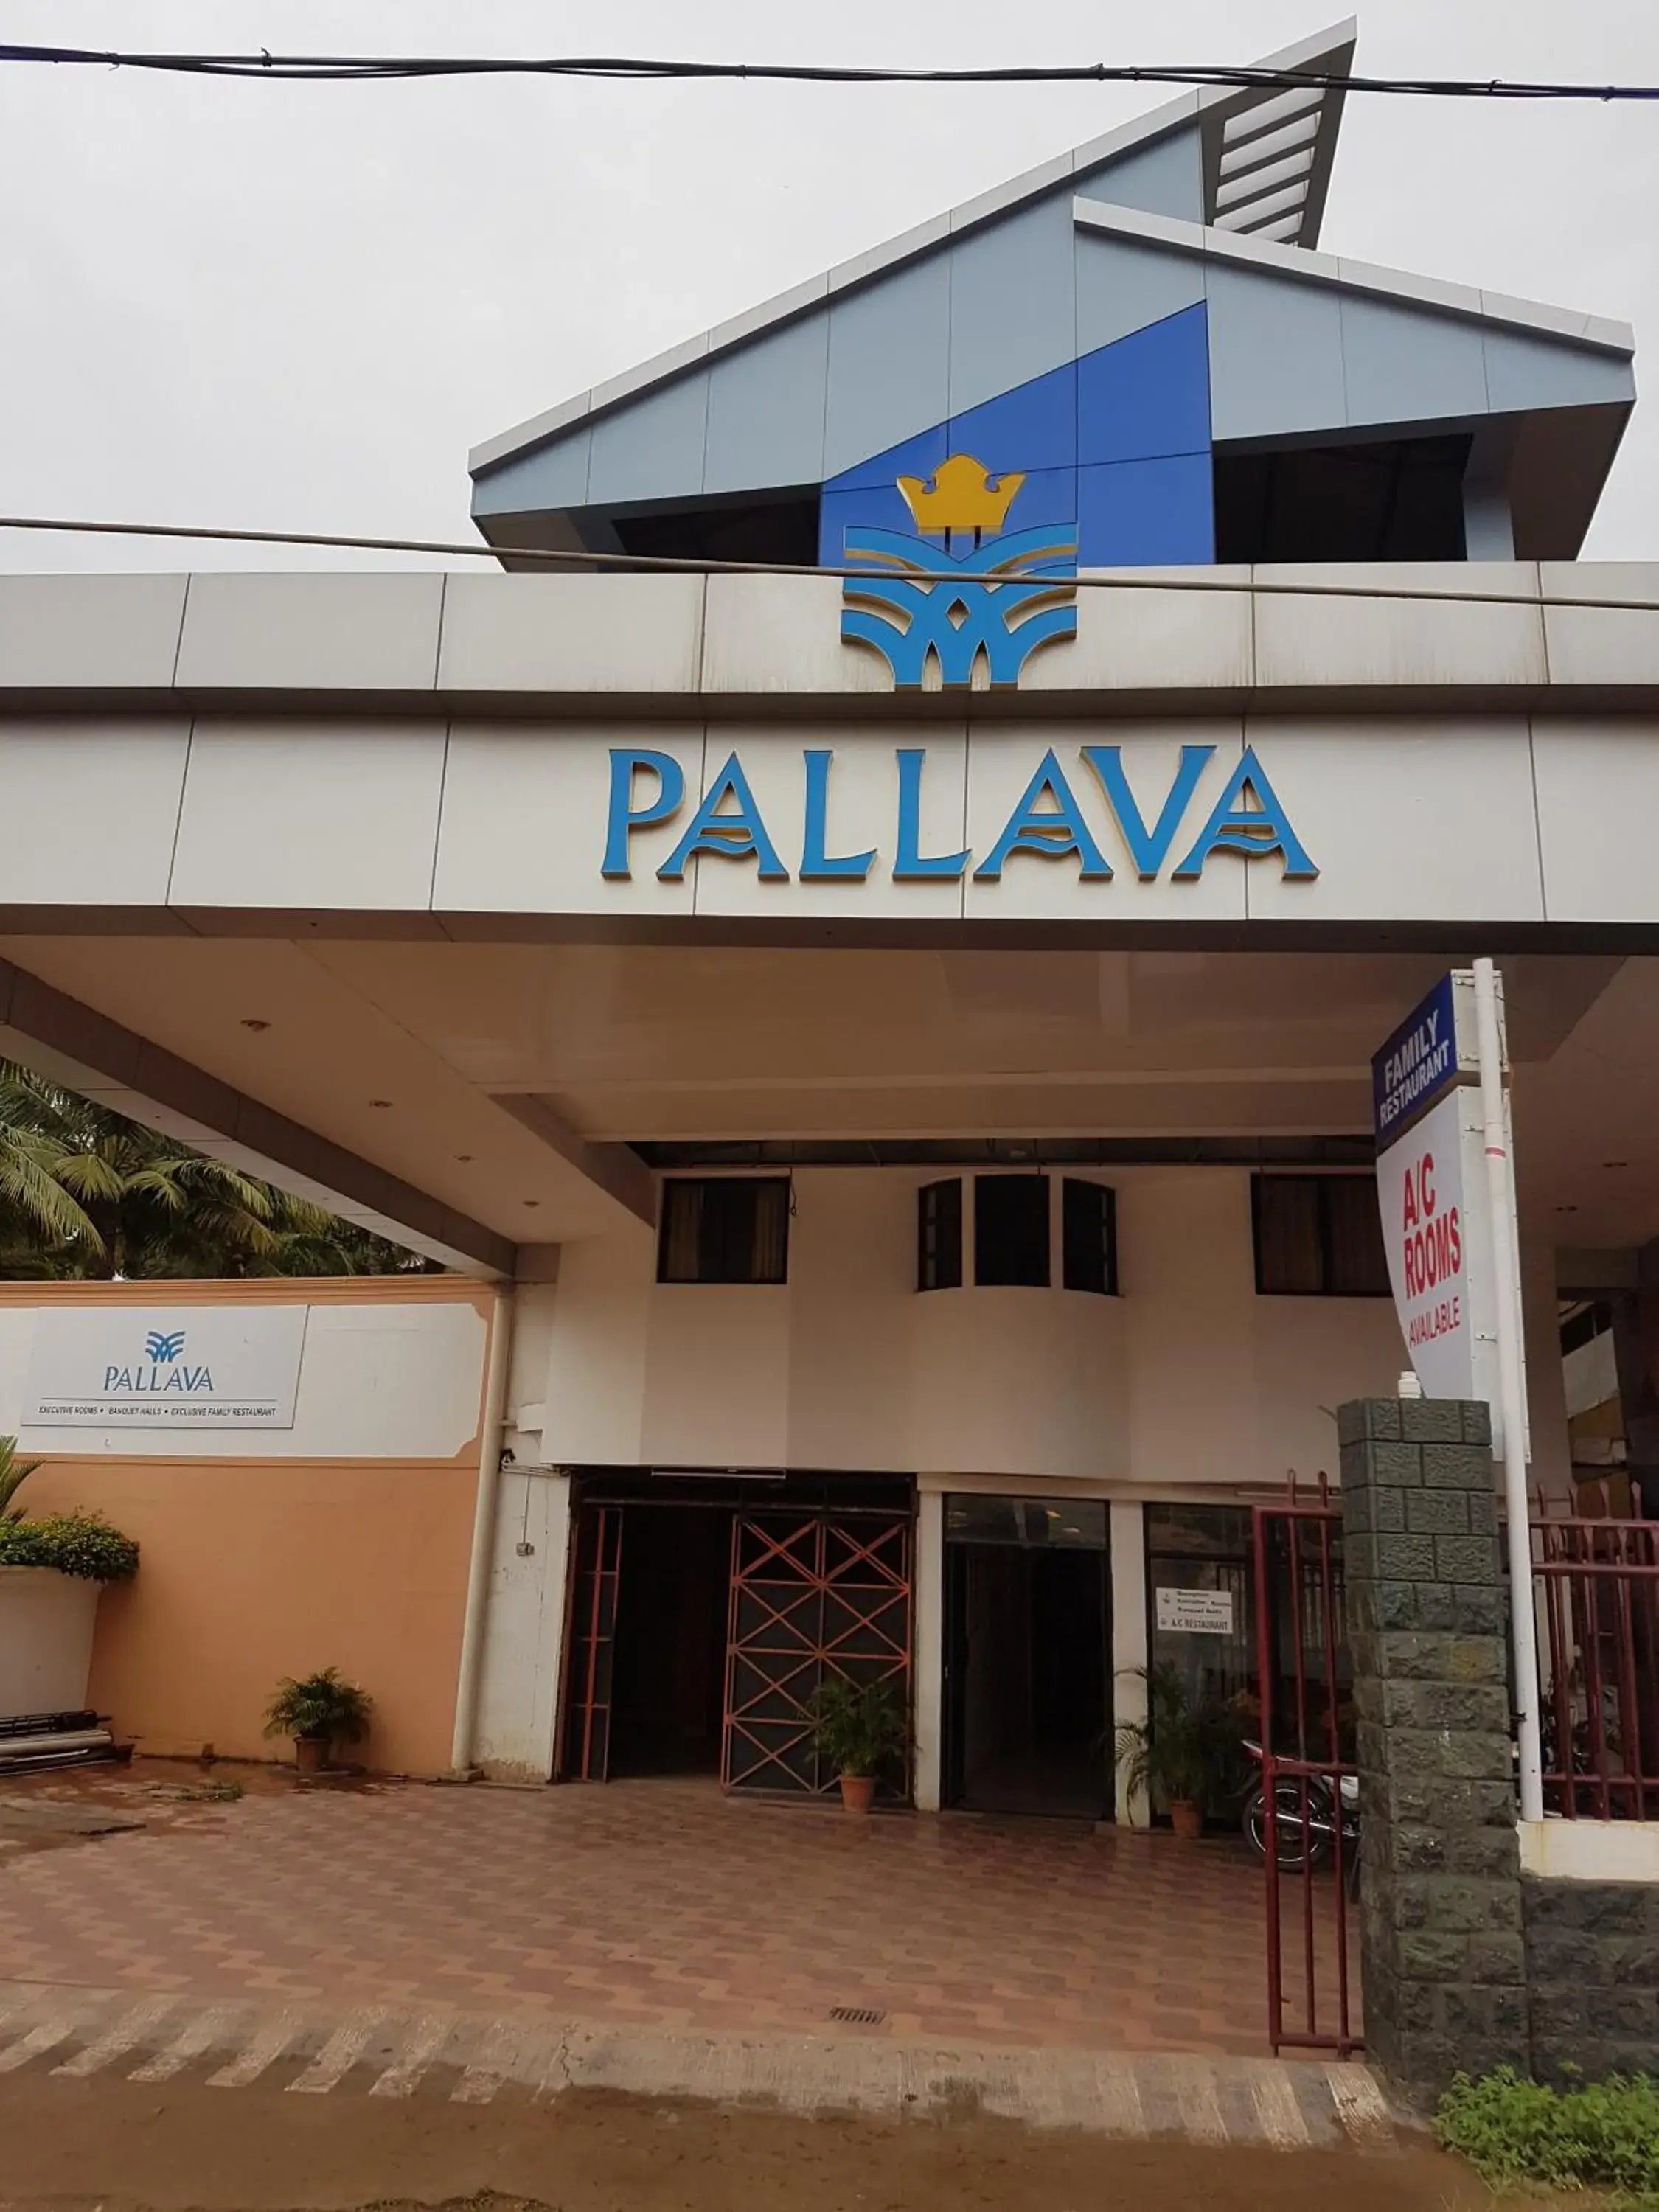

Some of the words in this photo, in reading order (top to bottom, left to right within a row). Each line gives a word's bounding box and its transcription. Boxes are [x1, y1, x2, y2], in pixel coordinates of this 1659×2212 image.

[600, 744, 1321, 882] PALLAVA
[1380, 1038, 1450, 1130] RESTAURANT
[1384, 1009, 1439, 1093] FAMILY
[1403, 1152, 1435, 1231] A/C
[1404, 1207, 1461, 1301] ROOMS
[1409, 1296, 1460, 1350] AVAILABLE
[38, 1405, 73, 1414] EXECUTIVE
[74, 1406, 98, 1415] ROOMS
[108, 1406, 139, 1415] BANQUET
[140, 1407, 162, 1416] HALLS
[170, 1407, 207, 1416] EXCLUSIVE
[207, 1408, 231, 1416] FAMILY
[232, 1408, 276, 1416] RESTAURANT
[103, 1366, 214, 1392] PALLAVA
